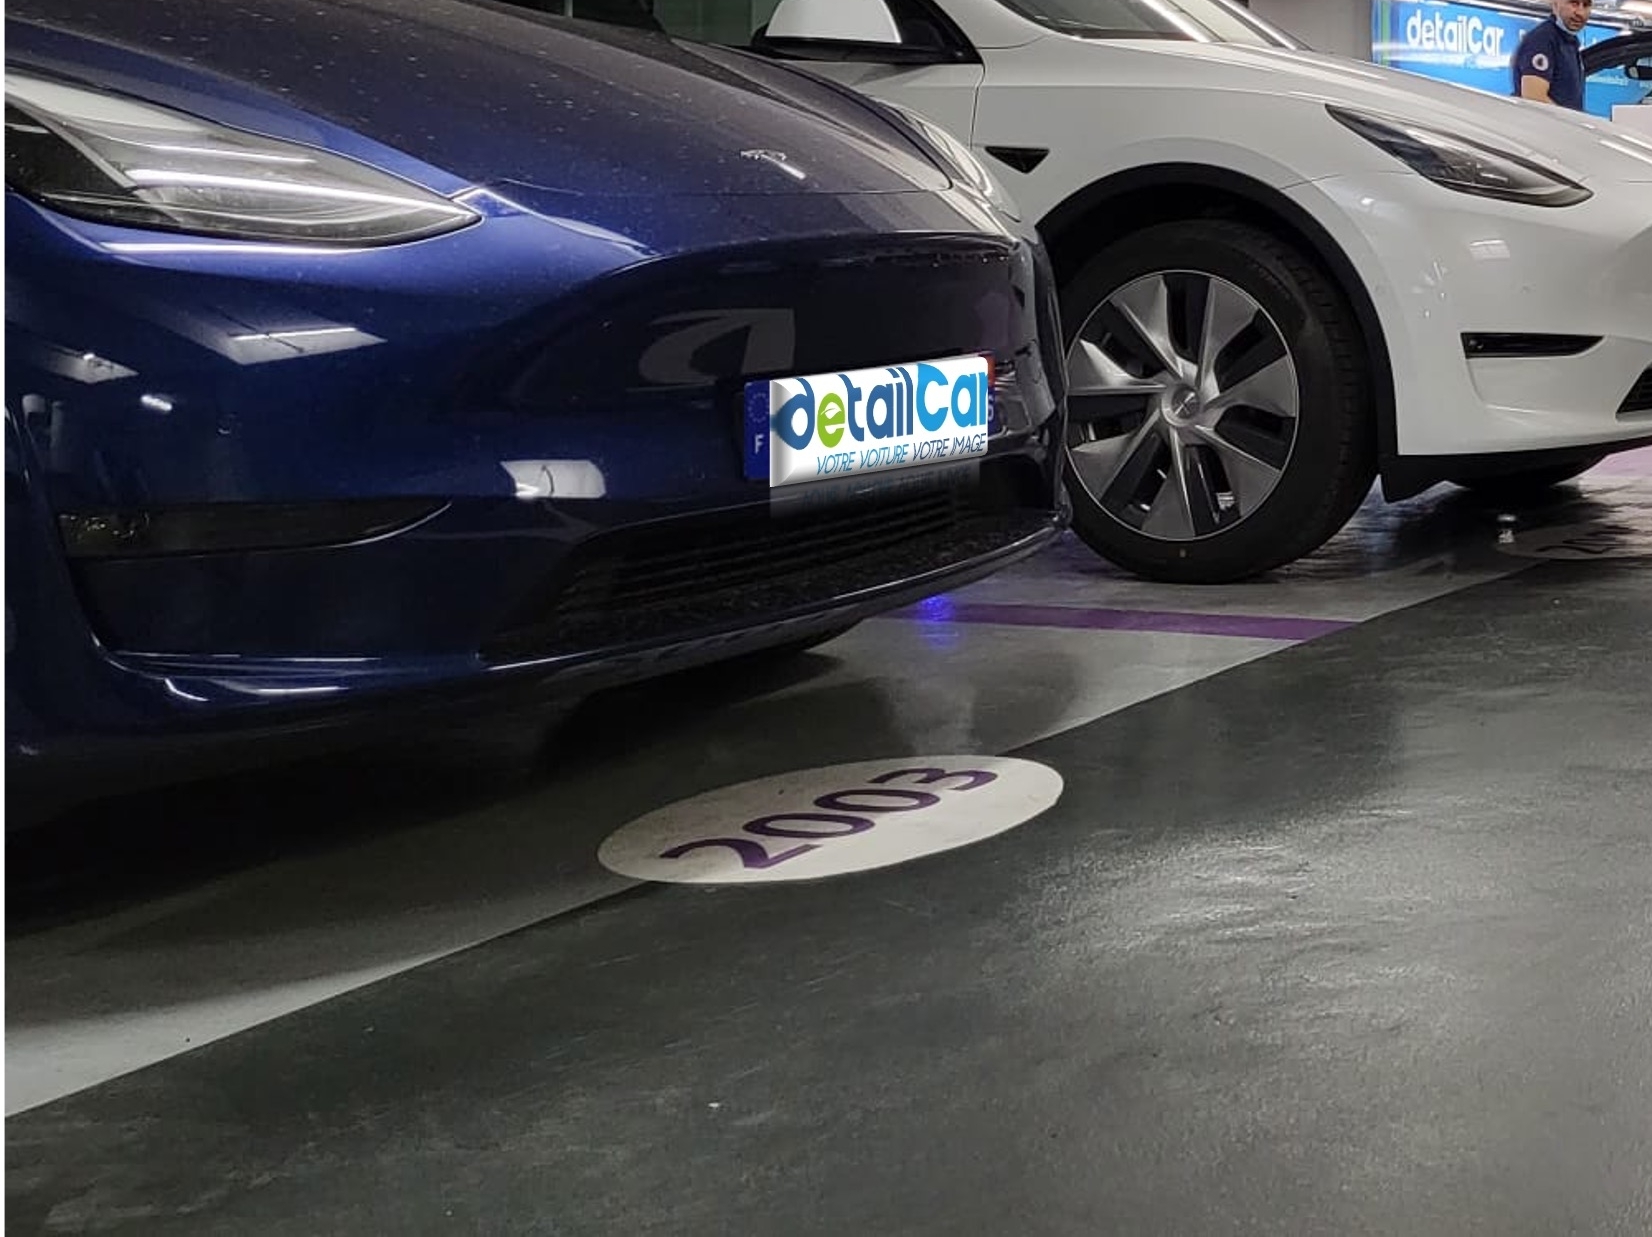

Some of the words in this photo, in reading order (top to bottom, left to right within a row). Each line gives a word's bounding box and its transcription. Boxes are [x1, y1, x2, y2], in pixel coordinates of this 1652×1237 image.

[1406, 9, 1504, 57] detailCar
[754, 434, 765, 455] F
[659, 767, 998, 868] 2003
